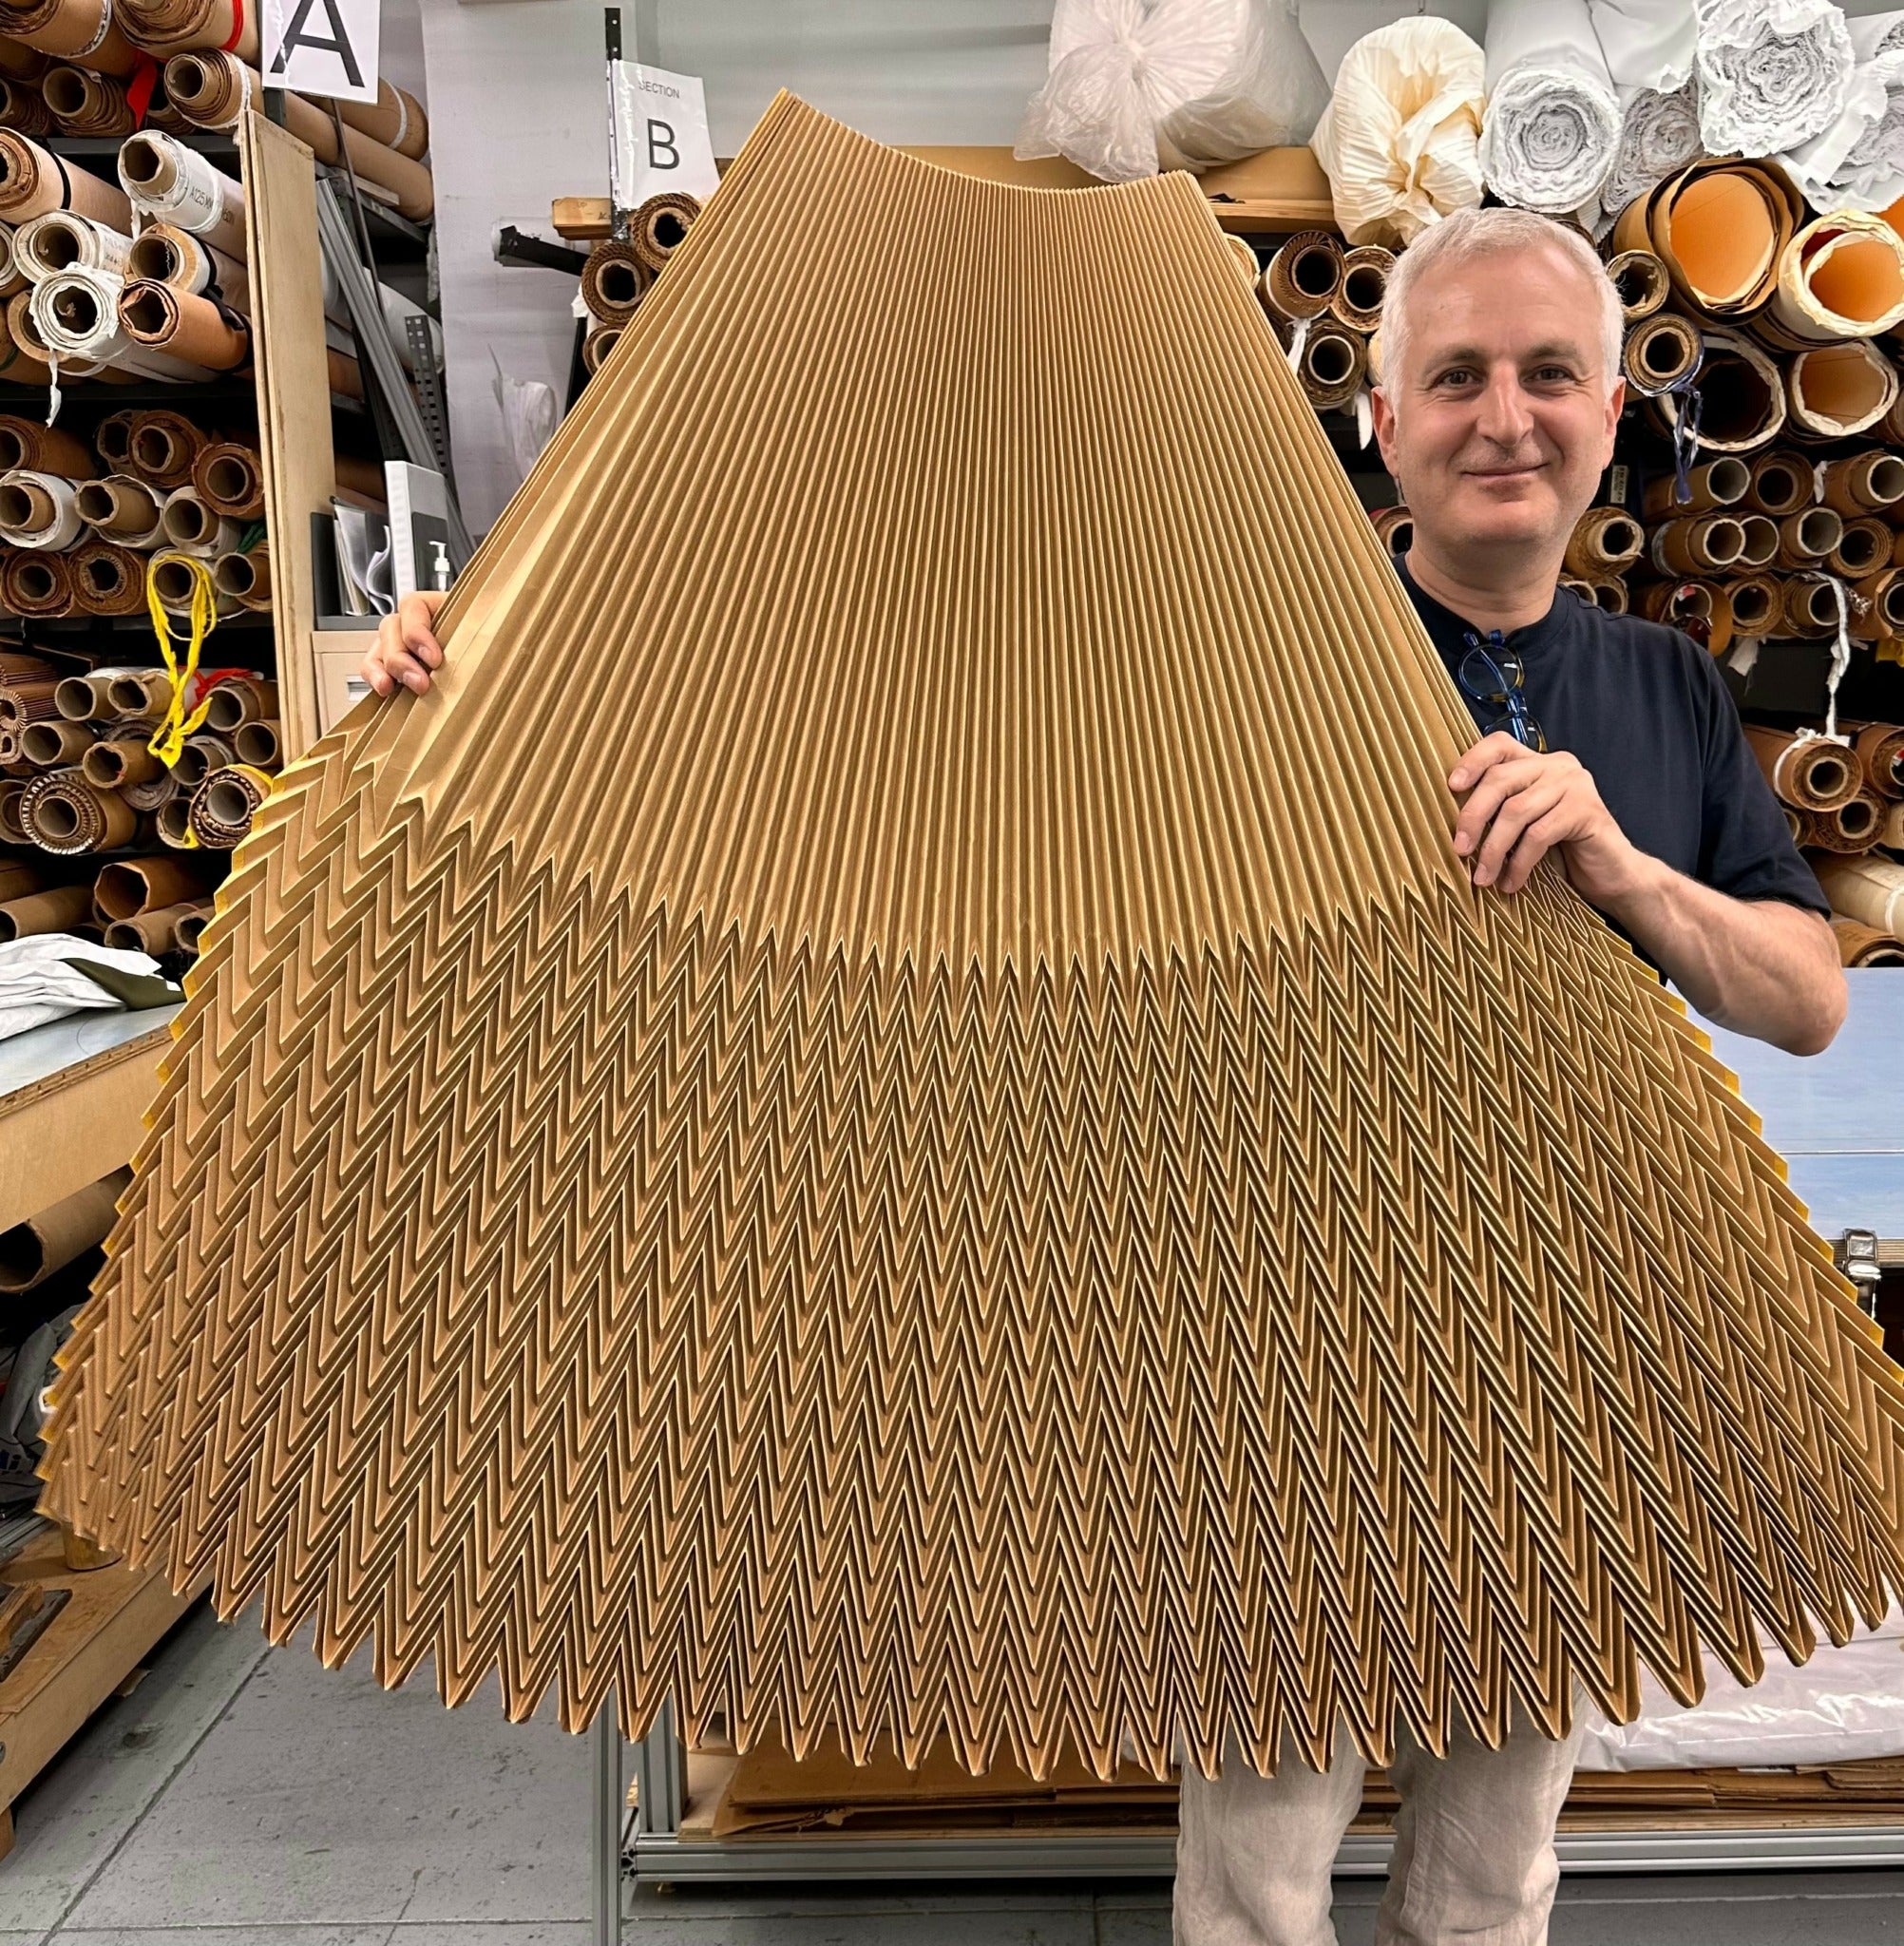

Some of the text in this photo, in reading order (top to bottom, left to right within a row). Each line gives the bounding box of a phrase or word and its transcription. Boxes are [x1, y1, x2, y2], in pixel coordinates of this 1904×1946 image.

[270, 0, 365, 87] A
[638, 81, 679, 99] SECTION
[647, 118, 679, 169] B
